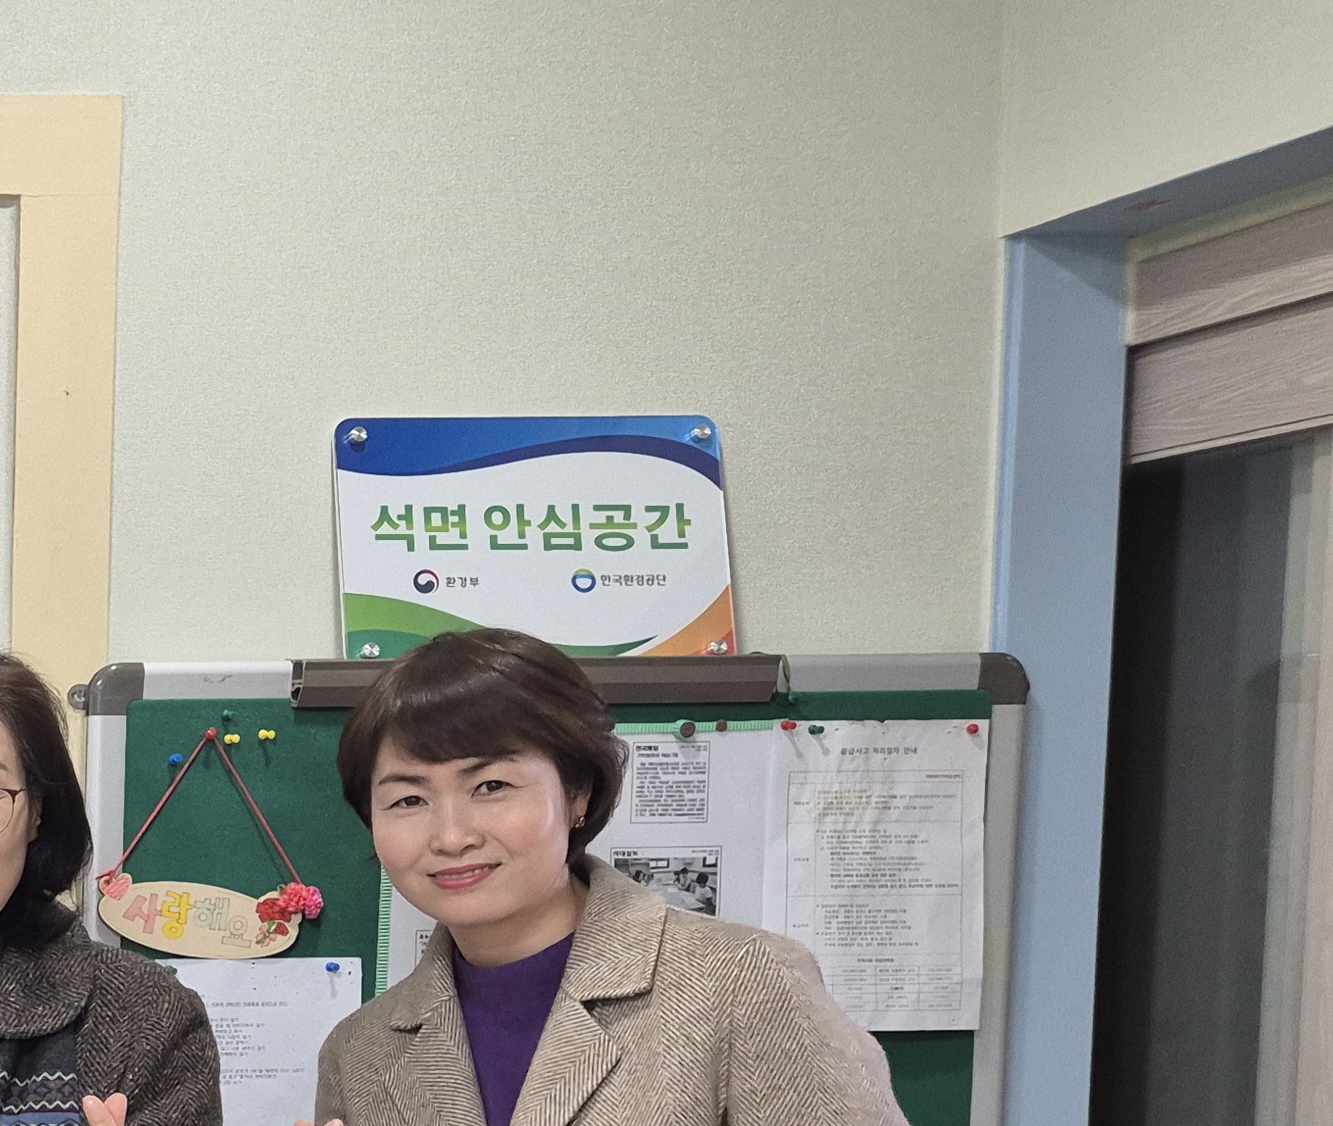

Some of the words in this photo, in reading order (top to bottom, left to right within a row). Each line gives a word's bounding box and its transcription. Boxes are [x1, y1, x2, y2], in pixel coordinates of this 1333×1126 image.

[369, 505, 469, 553] 석면
[483, 502, 692, 553] 안심공간
[445, 576, 480, 588] 환경부
[601, 574, 666, 587] 한국환경공단
[903, 746, 918, 755] 안내
[122, 890, 252, 948] 사랑해요
